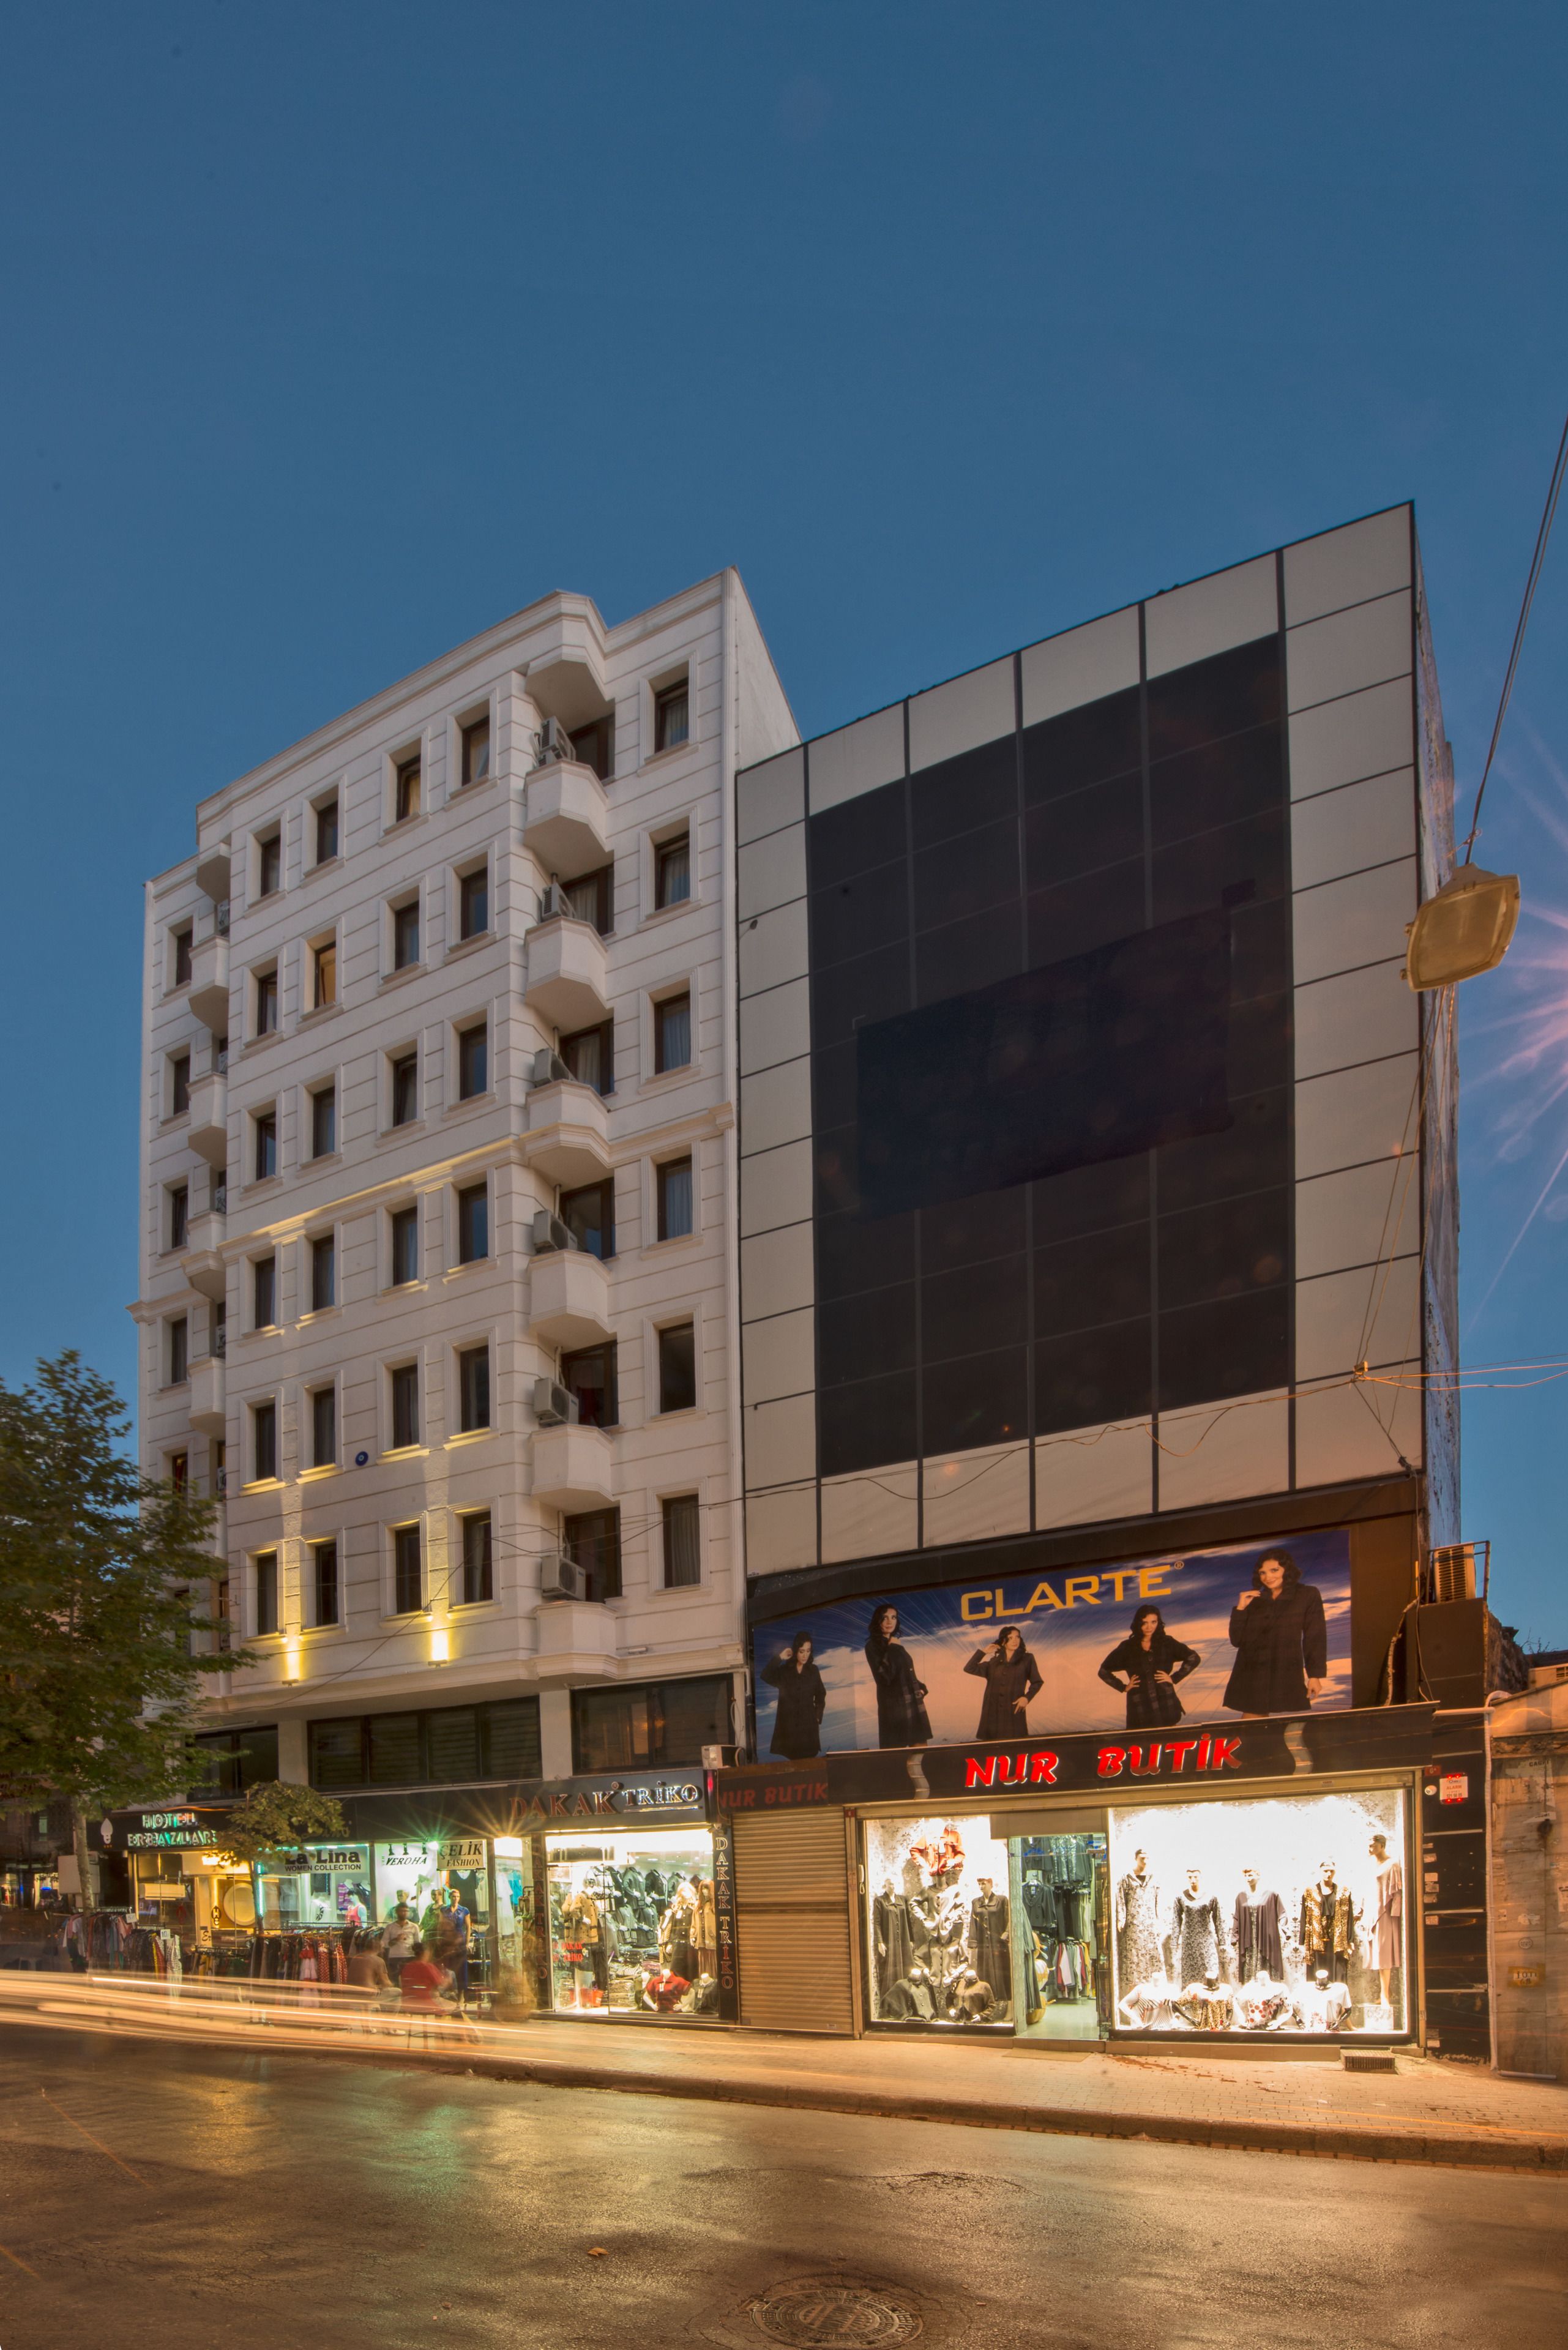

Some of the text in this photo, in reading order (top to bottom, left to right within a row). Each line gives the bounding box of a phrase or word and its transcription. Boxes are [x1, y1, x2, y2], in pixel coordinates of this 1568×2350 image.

[961, 1565, 1171, 1621] CLARTE
[965, 1733, 1242, 1788] NUR BUTİK
[509, 1781, 698, 1819] DAKAK TRİKO
[142, 1812, 197, 1829] HOTEL
[285, 1849, 361, 1865] La Lina
[439, 1841, 482, 1859] ÇELİK
[447, 1858, 480, 1867] FASHION
[715, 1837, 734, 1989] DAKAK TRİKO
